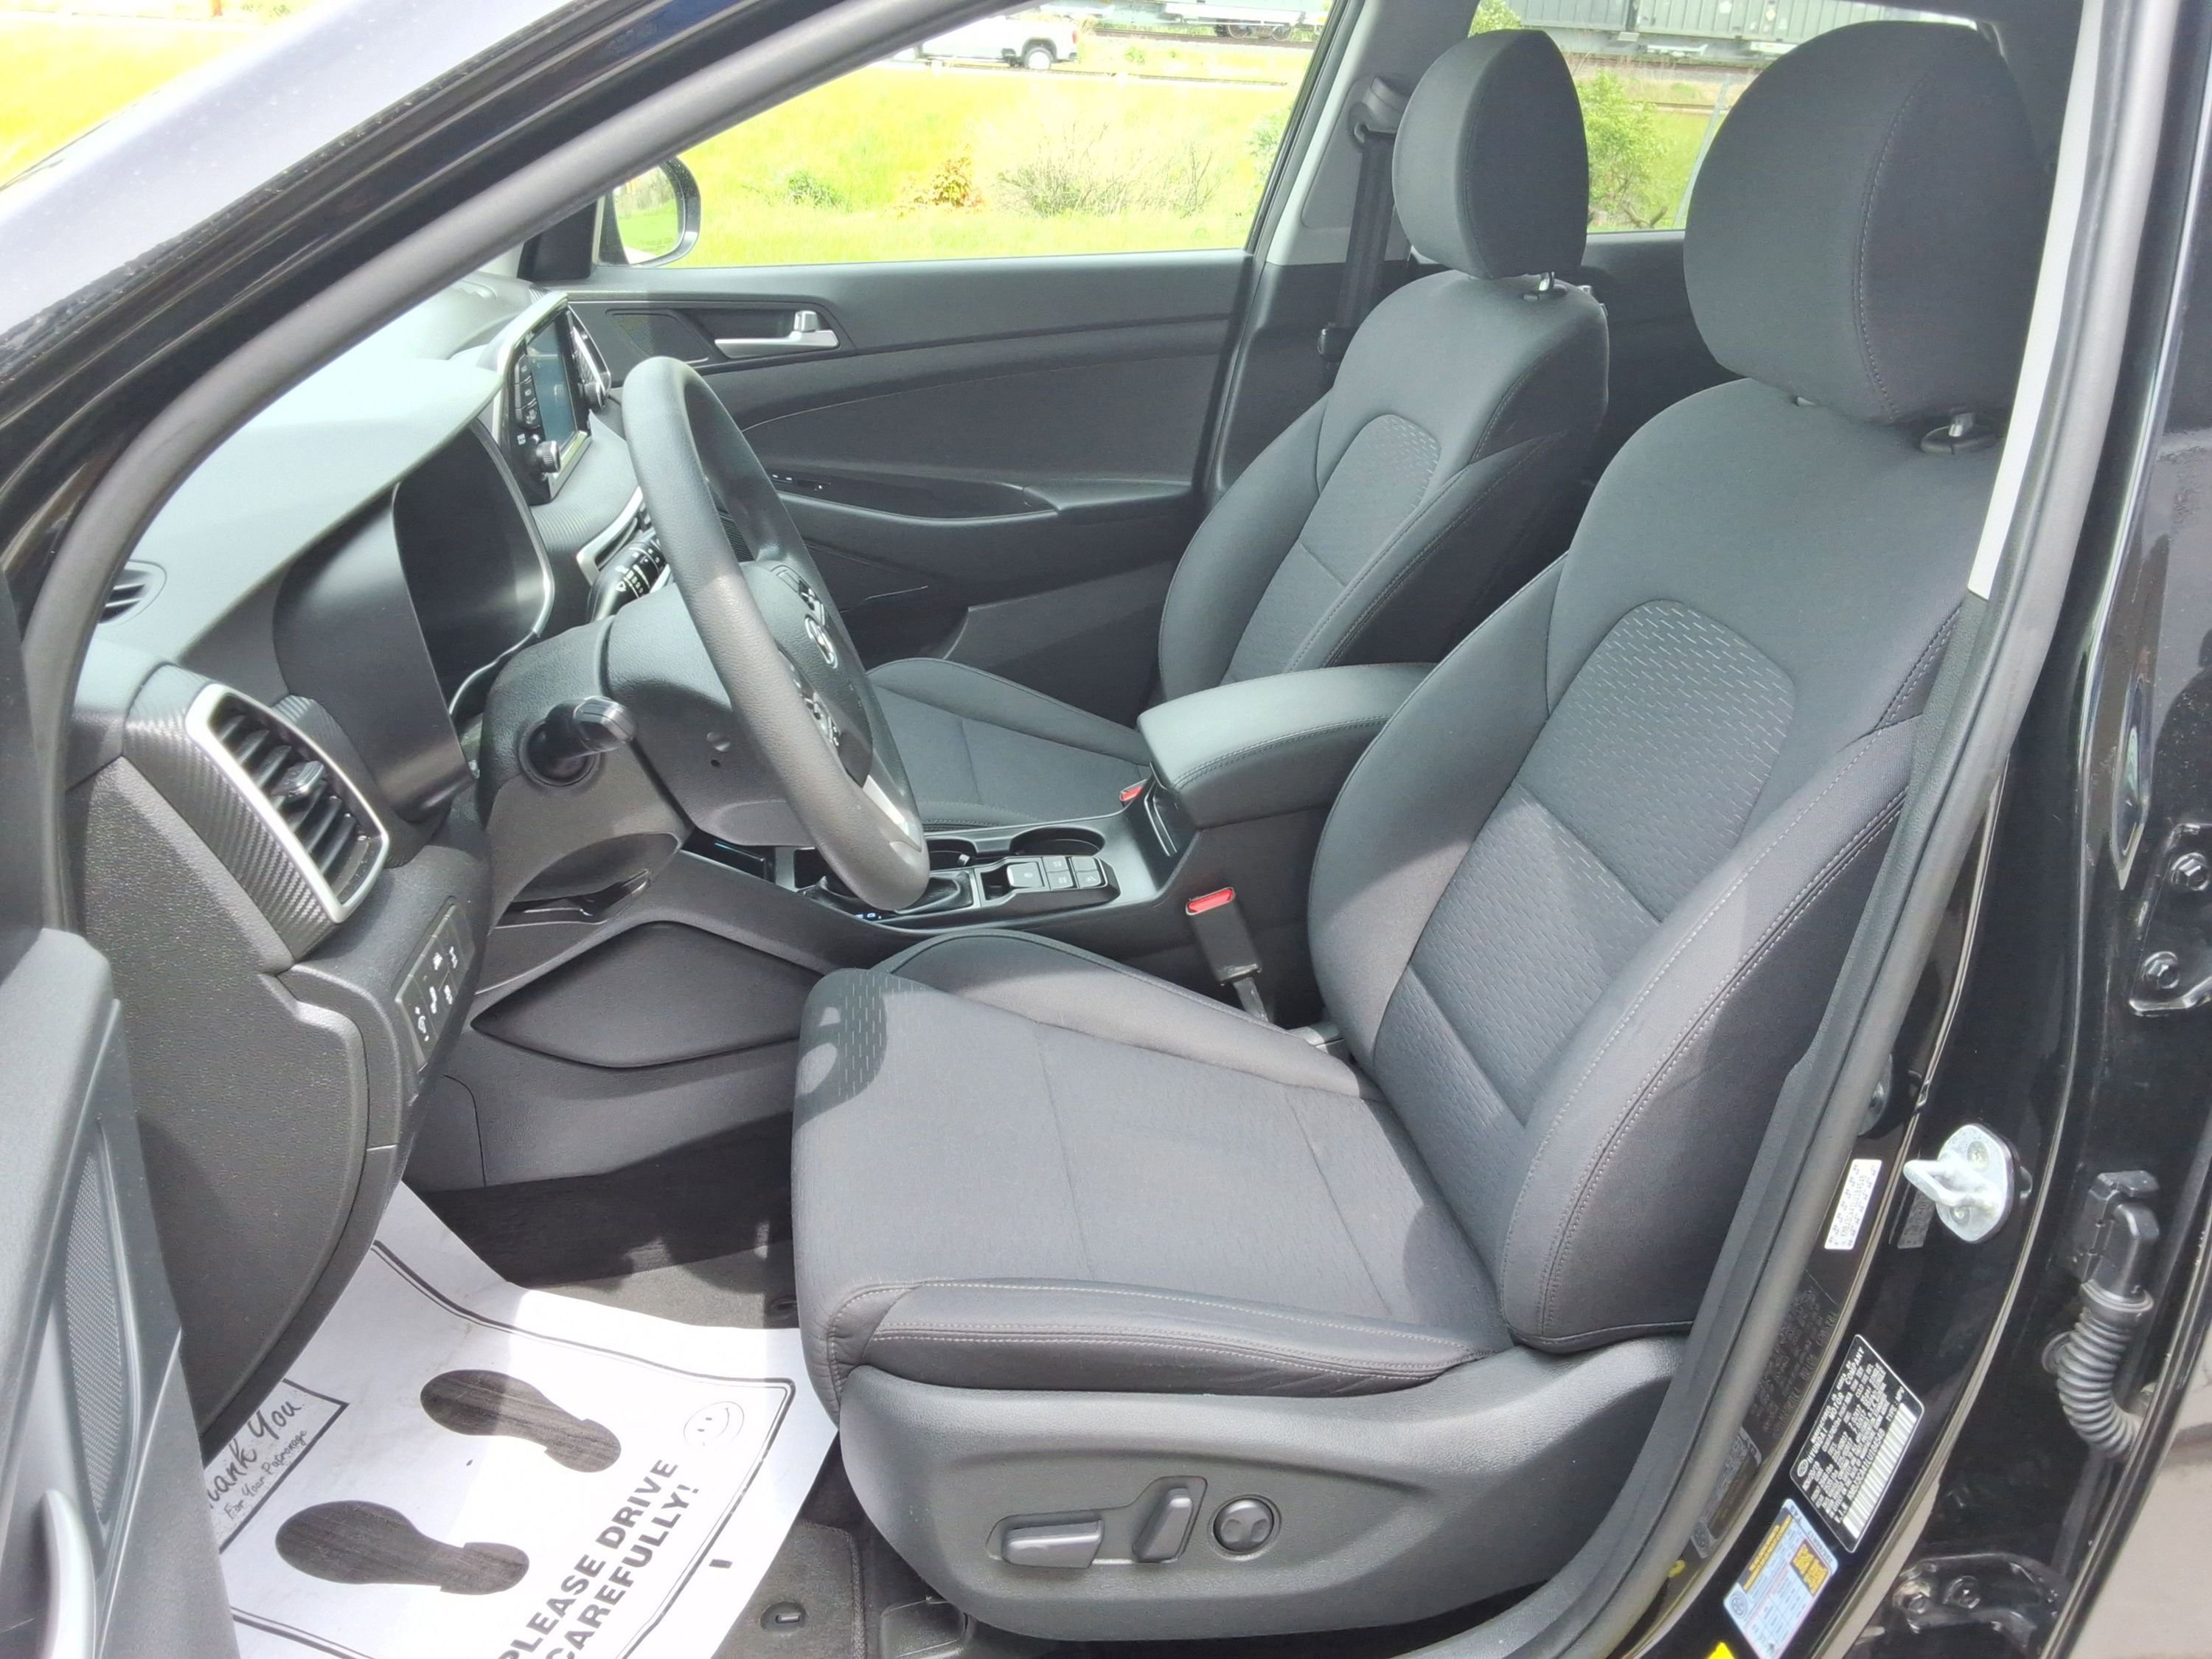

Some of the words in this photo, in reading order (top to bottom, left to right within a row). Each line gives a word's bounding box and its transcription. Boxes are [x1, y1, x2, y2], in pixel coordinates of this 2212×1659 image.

[247, 1402, 302, 1440] You
[1806, 1425, 1827, 1464] HYUNDAI
[1828, 1391, 1844, 1421] MOTOR
[1843, 1346, 1865, 1386] COMPANY
[262, 1430, 307, 1475] Patronage
[595, 1459, 678, 1549] DRIVE
